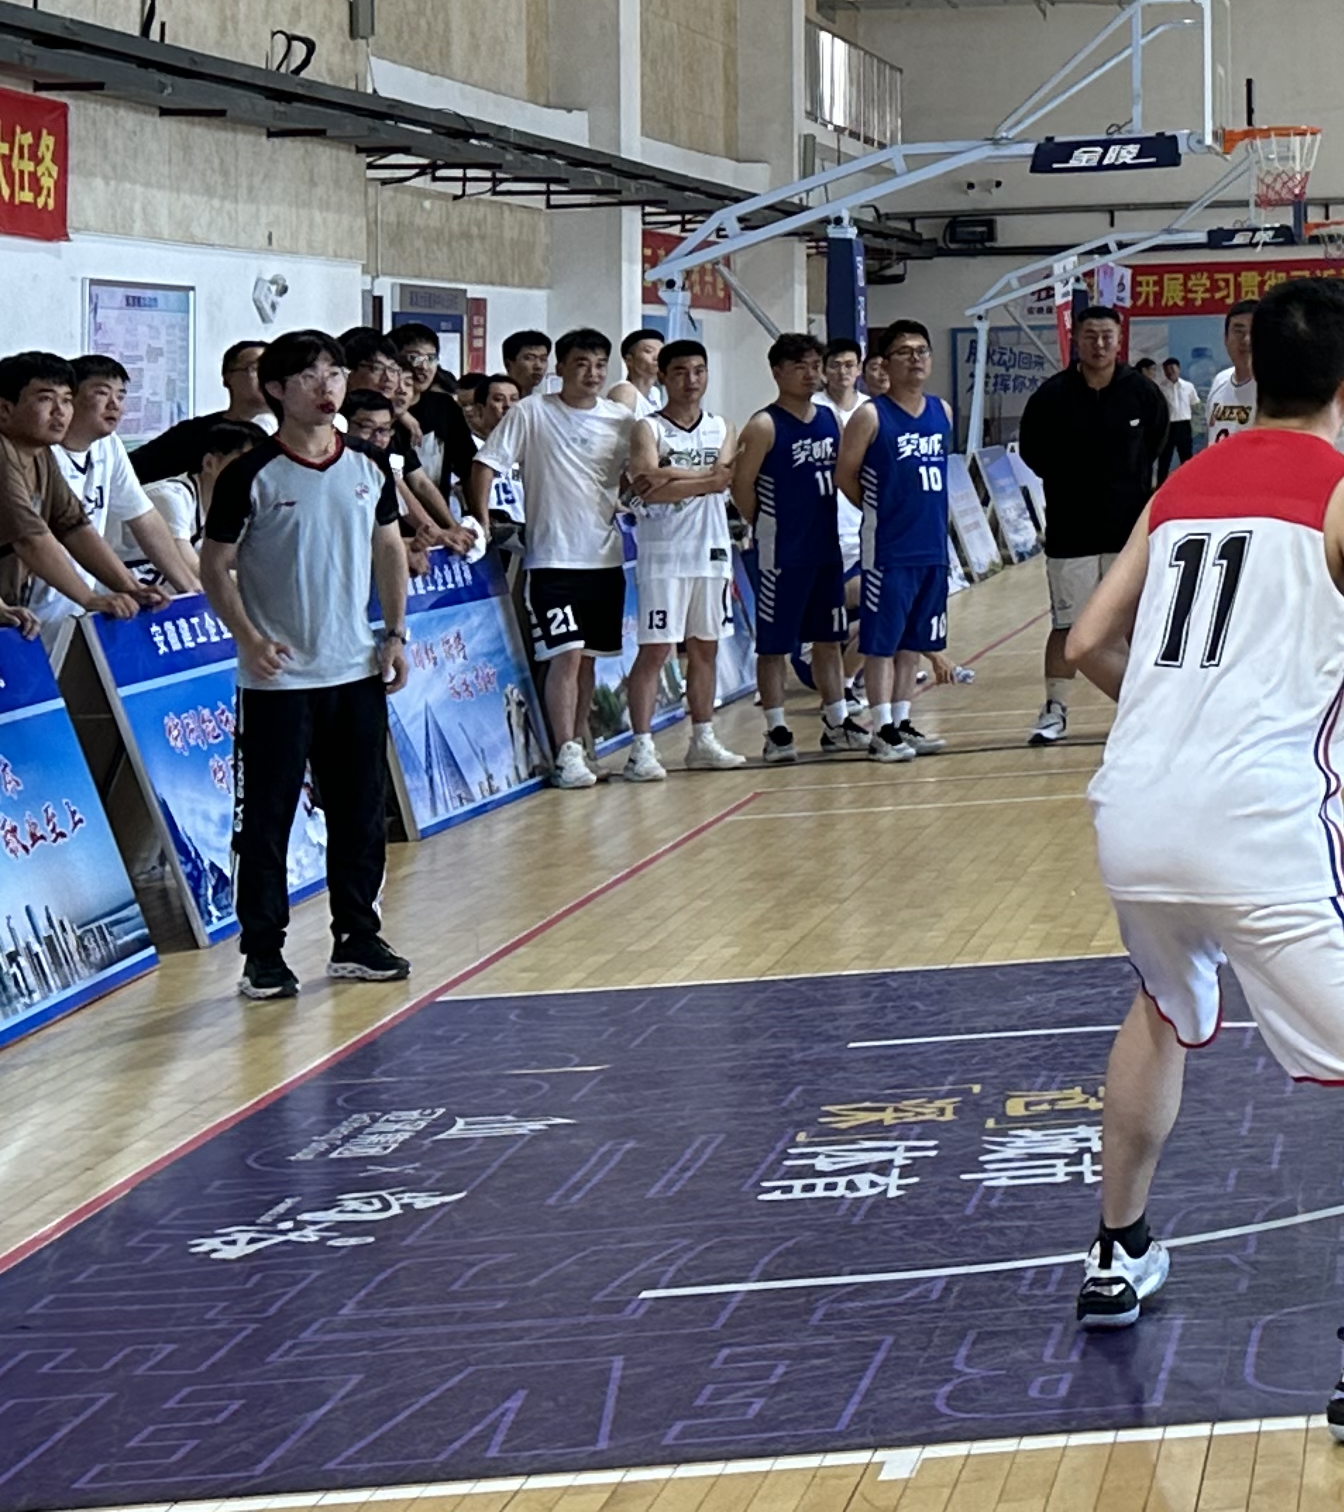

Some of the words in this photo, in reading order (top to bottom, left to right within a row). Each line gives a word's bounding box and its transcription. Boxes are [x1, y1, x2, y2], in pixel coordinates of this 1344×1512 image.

[1061, 144, 1150, 168] 金陵
[814, 470, 833, 497] 11
[918, 465, 943, 492] 10
[1154, 529, 1254, 669] 11
[546, 604, 579, 635] 21
[647, 609, 668, 630] 13
[831, 606, 849, 633] 11
